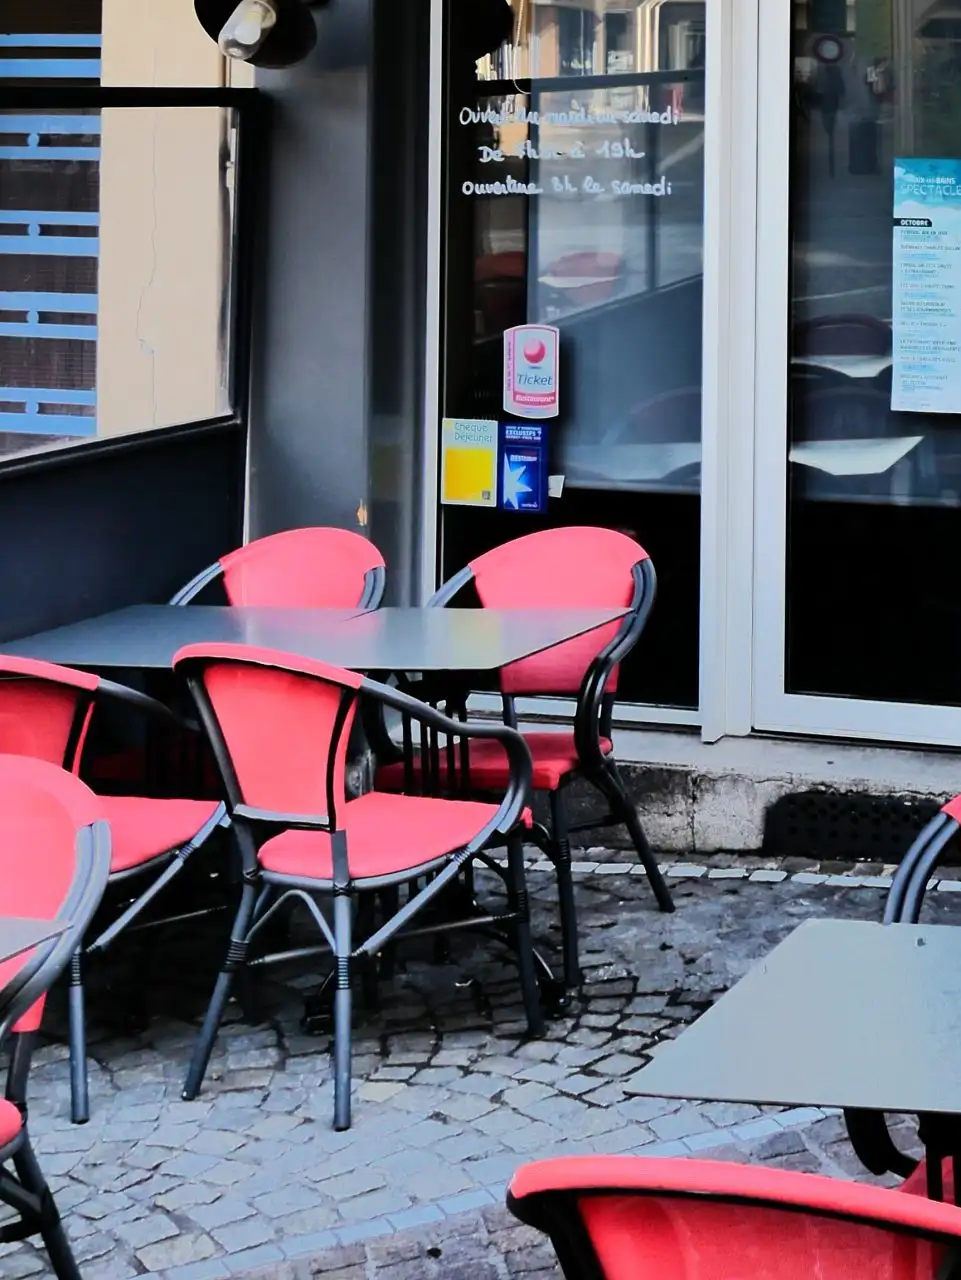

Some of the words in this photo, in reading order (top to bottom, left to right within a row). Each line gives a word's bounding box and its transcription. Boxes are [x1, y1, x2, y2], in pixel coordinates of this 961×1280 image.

[596, 137, 646, 159] 19h
[611, 176, 672, 196] samedi
[900, 219, 929, 227] OCTOBRE
[517, 373, 553, 386] Ticket
